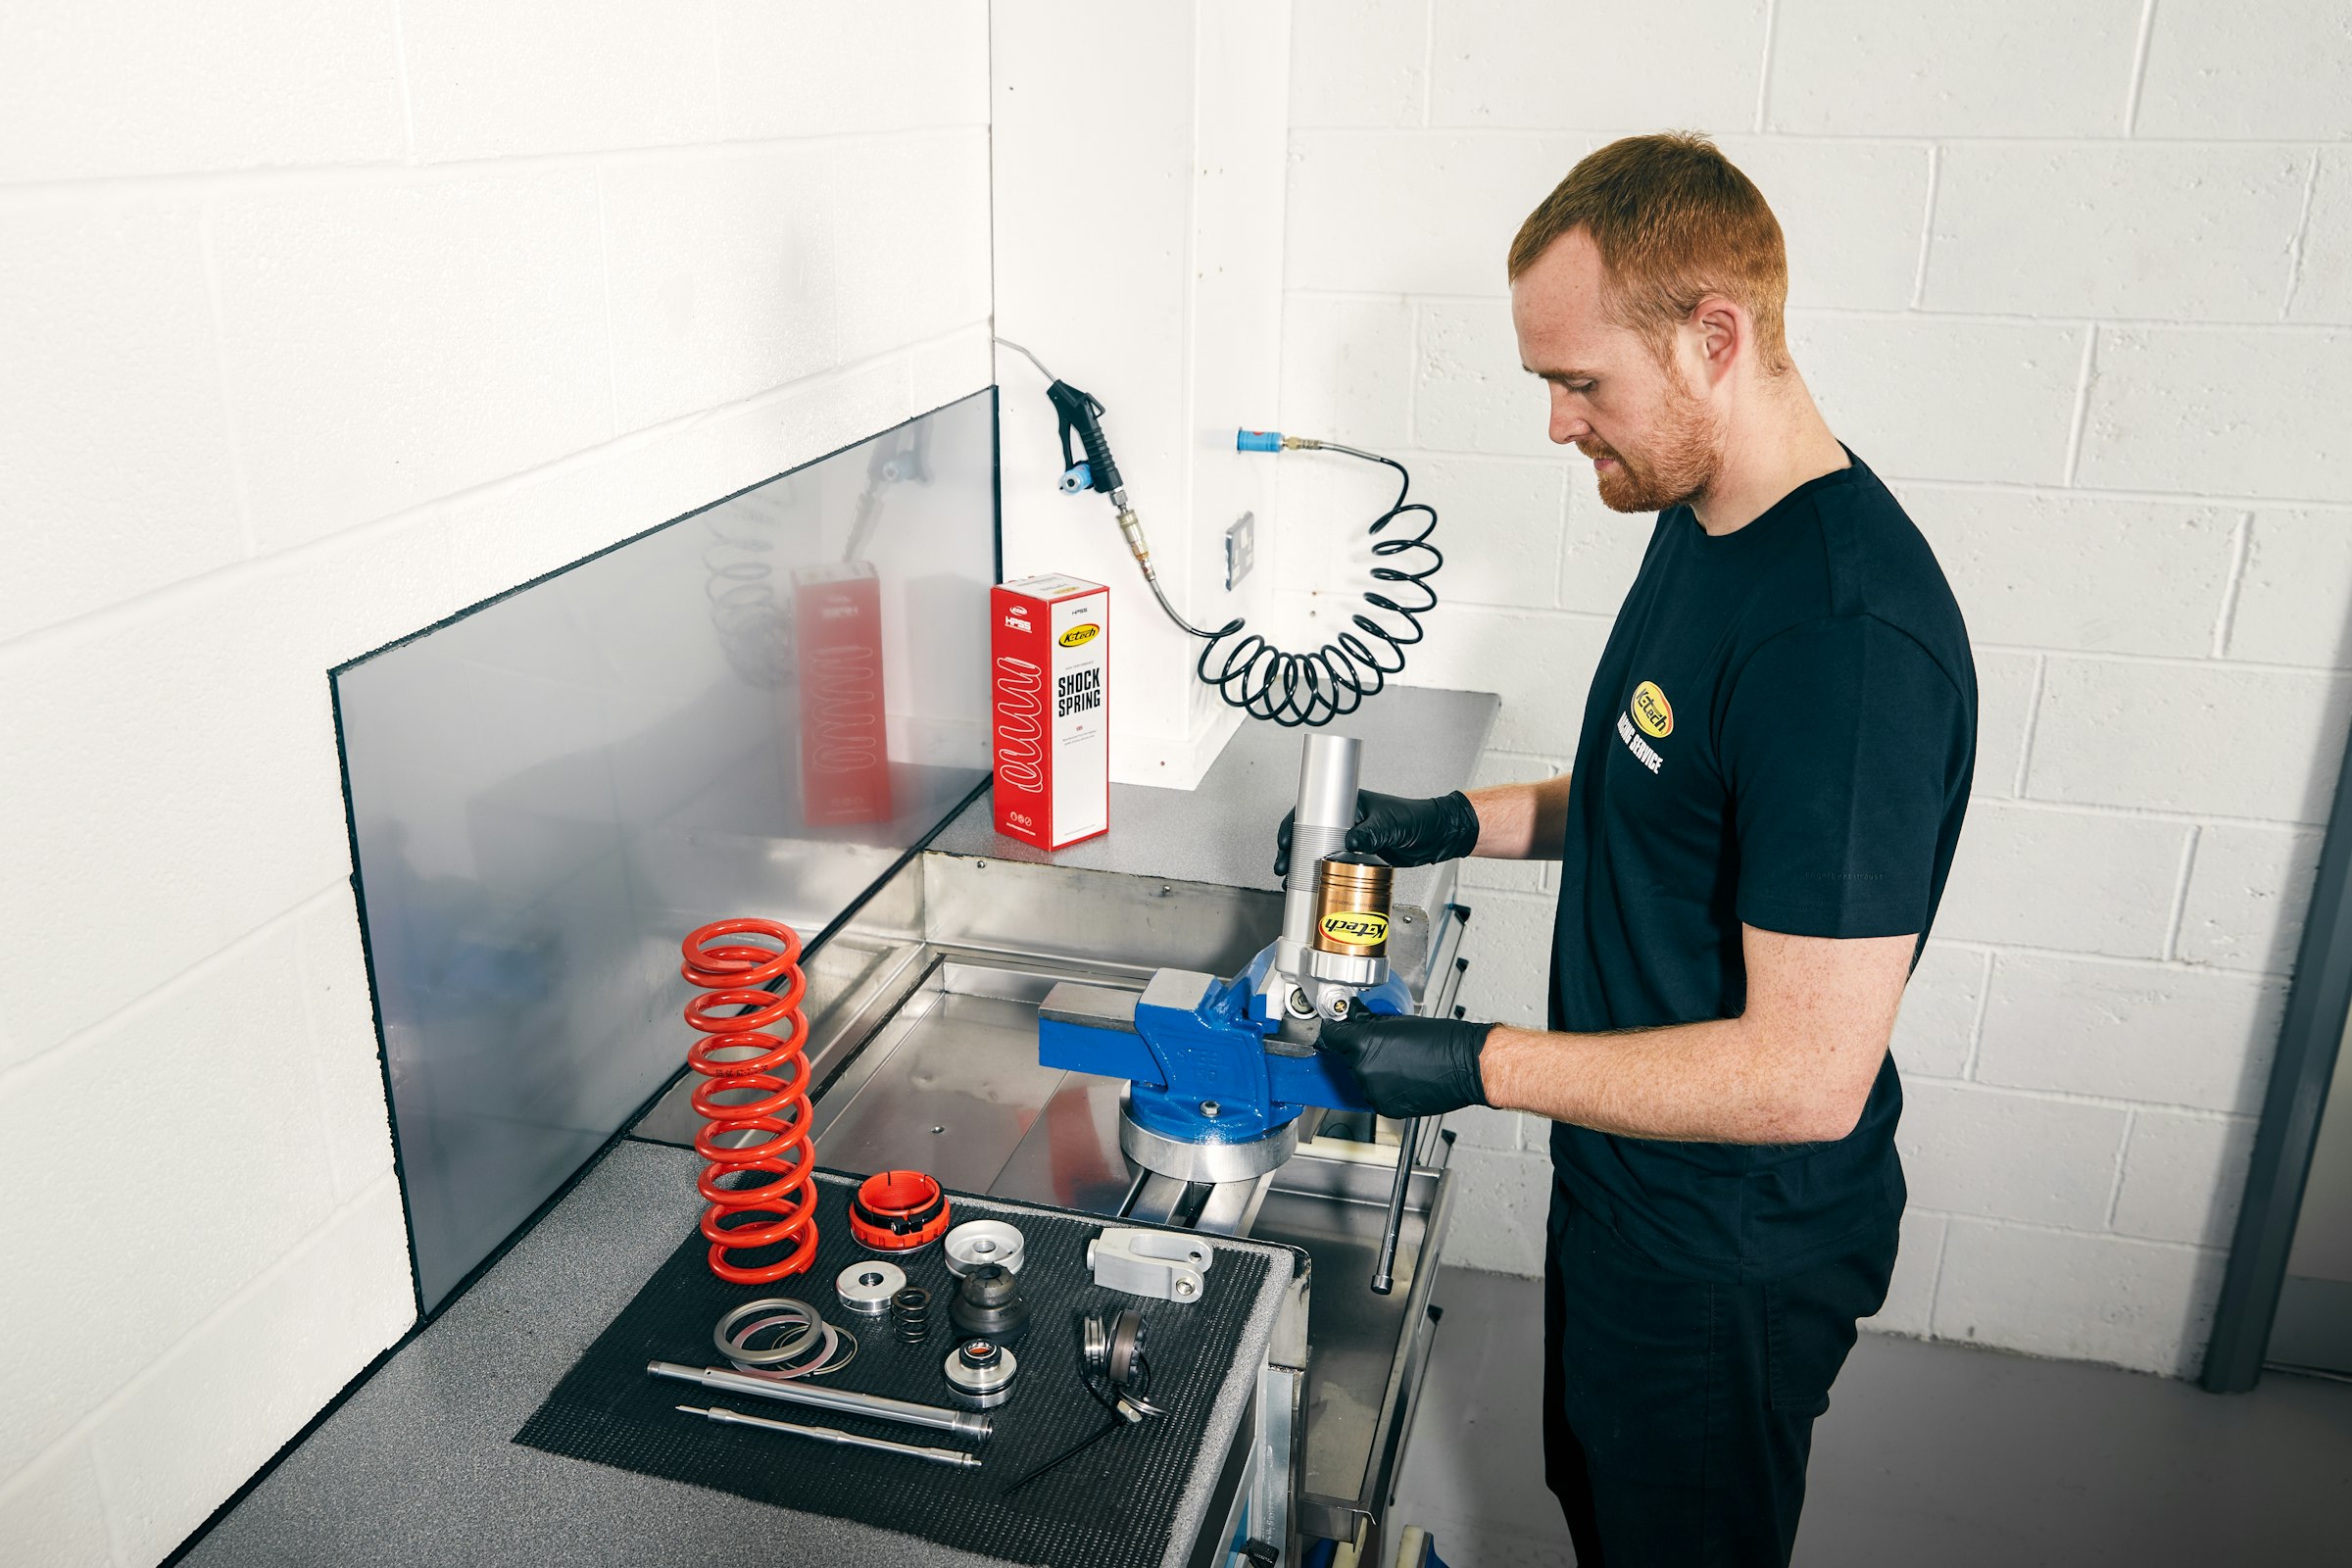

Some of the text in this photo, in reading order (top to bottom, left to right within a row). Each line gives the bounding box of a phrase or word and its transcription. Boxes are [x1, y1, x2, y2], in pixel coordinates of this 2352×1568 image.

[1058, 667, 1100, 698] SHOCK
[1058, 689, 1101, 717] SPRING
[1629, 733, 1664, 774] SERVICE
